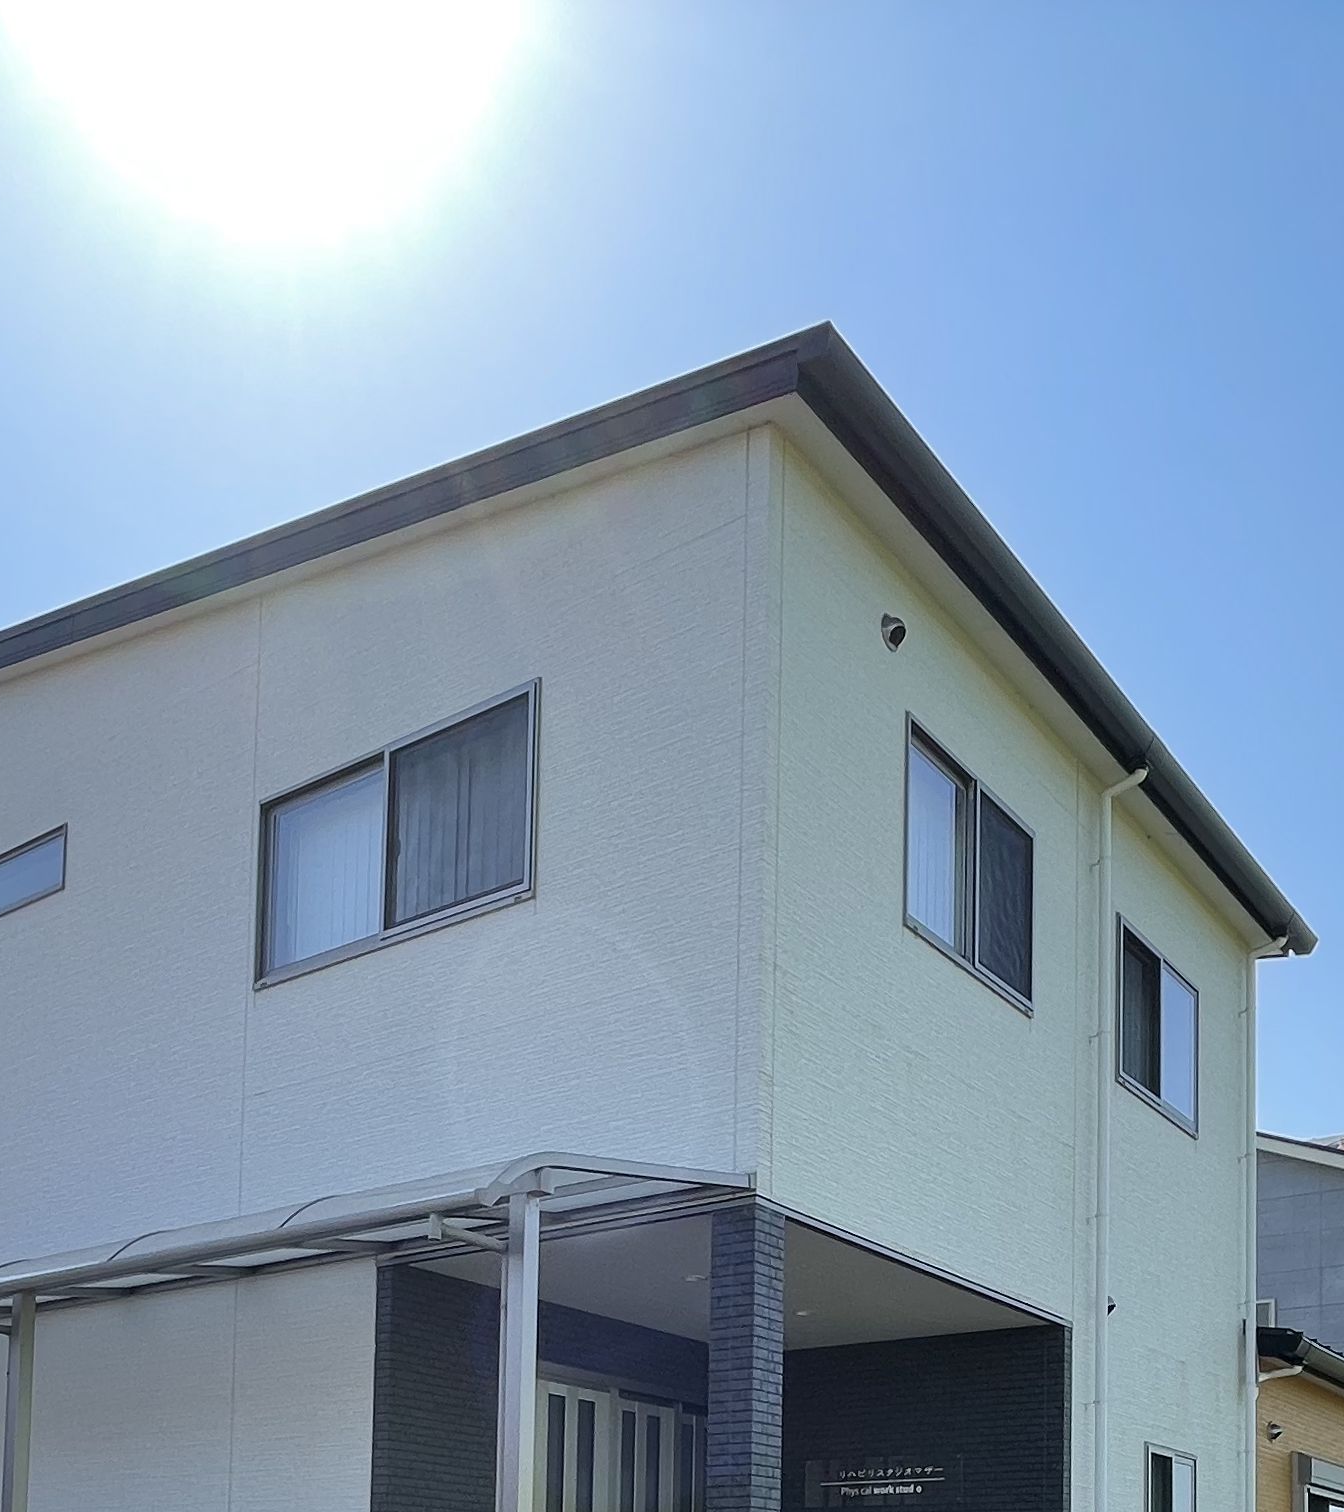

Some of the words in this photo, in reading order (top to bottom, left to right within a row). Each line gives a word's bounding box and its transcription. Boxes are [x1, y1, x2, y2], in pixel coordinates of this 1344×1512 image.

[841, 1485, 872, 1498] Physcal
[873, 1484, 894, 1494] work
[896, 1483, 922, 1494] studo
